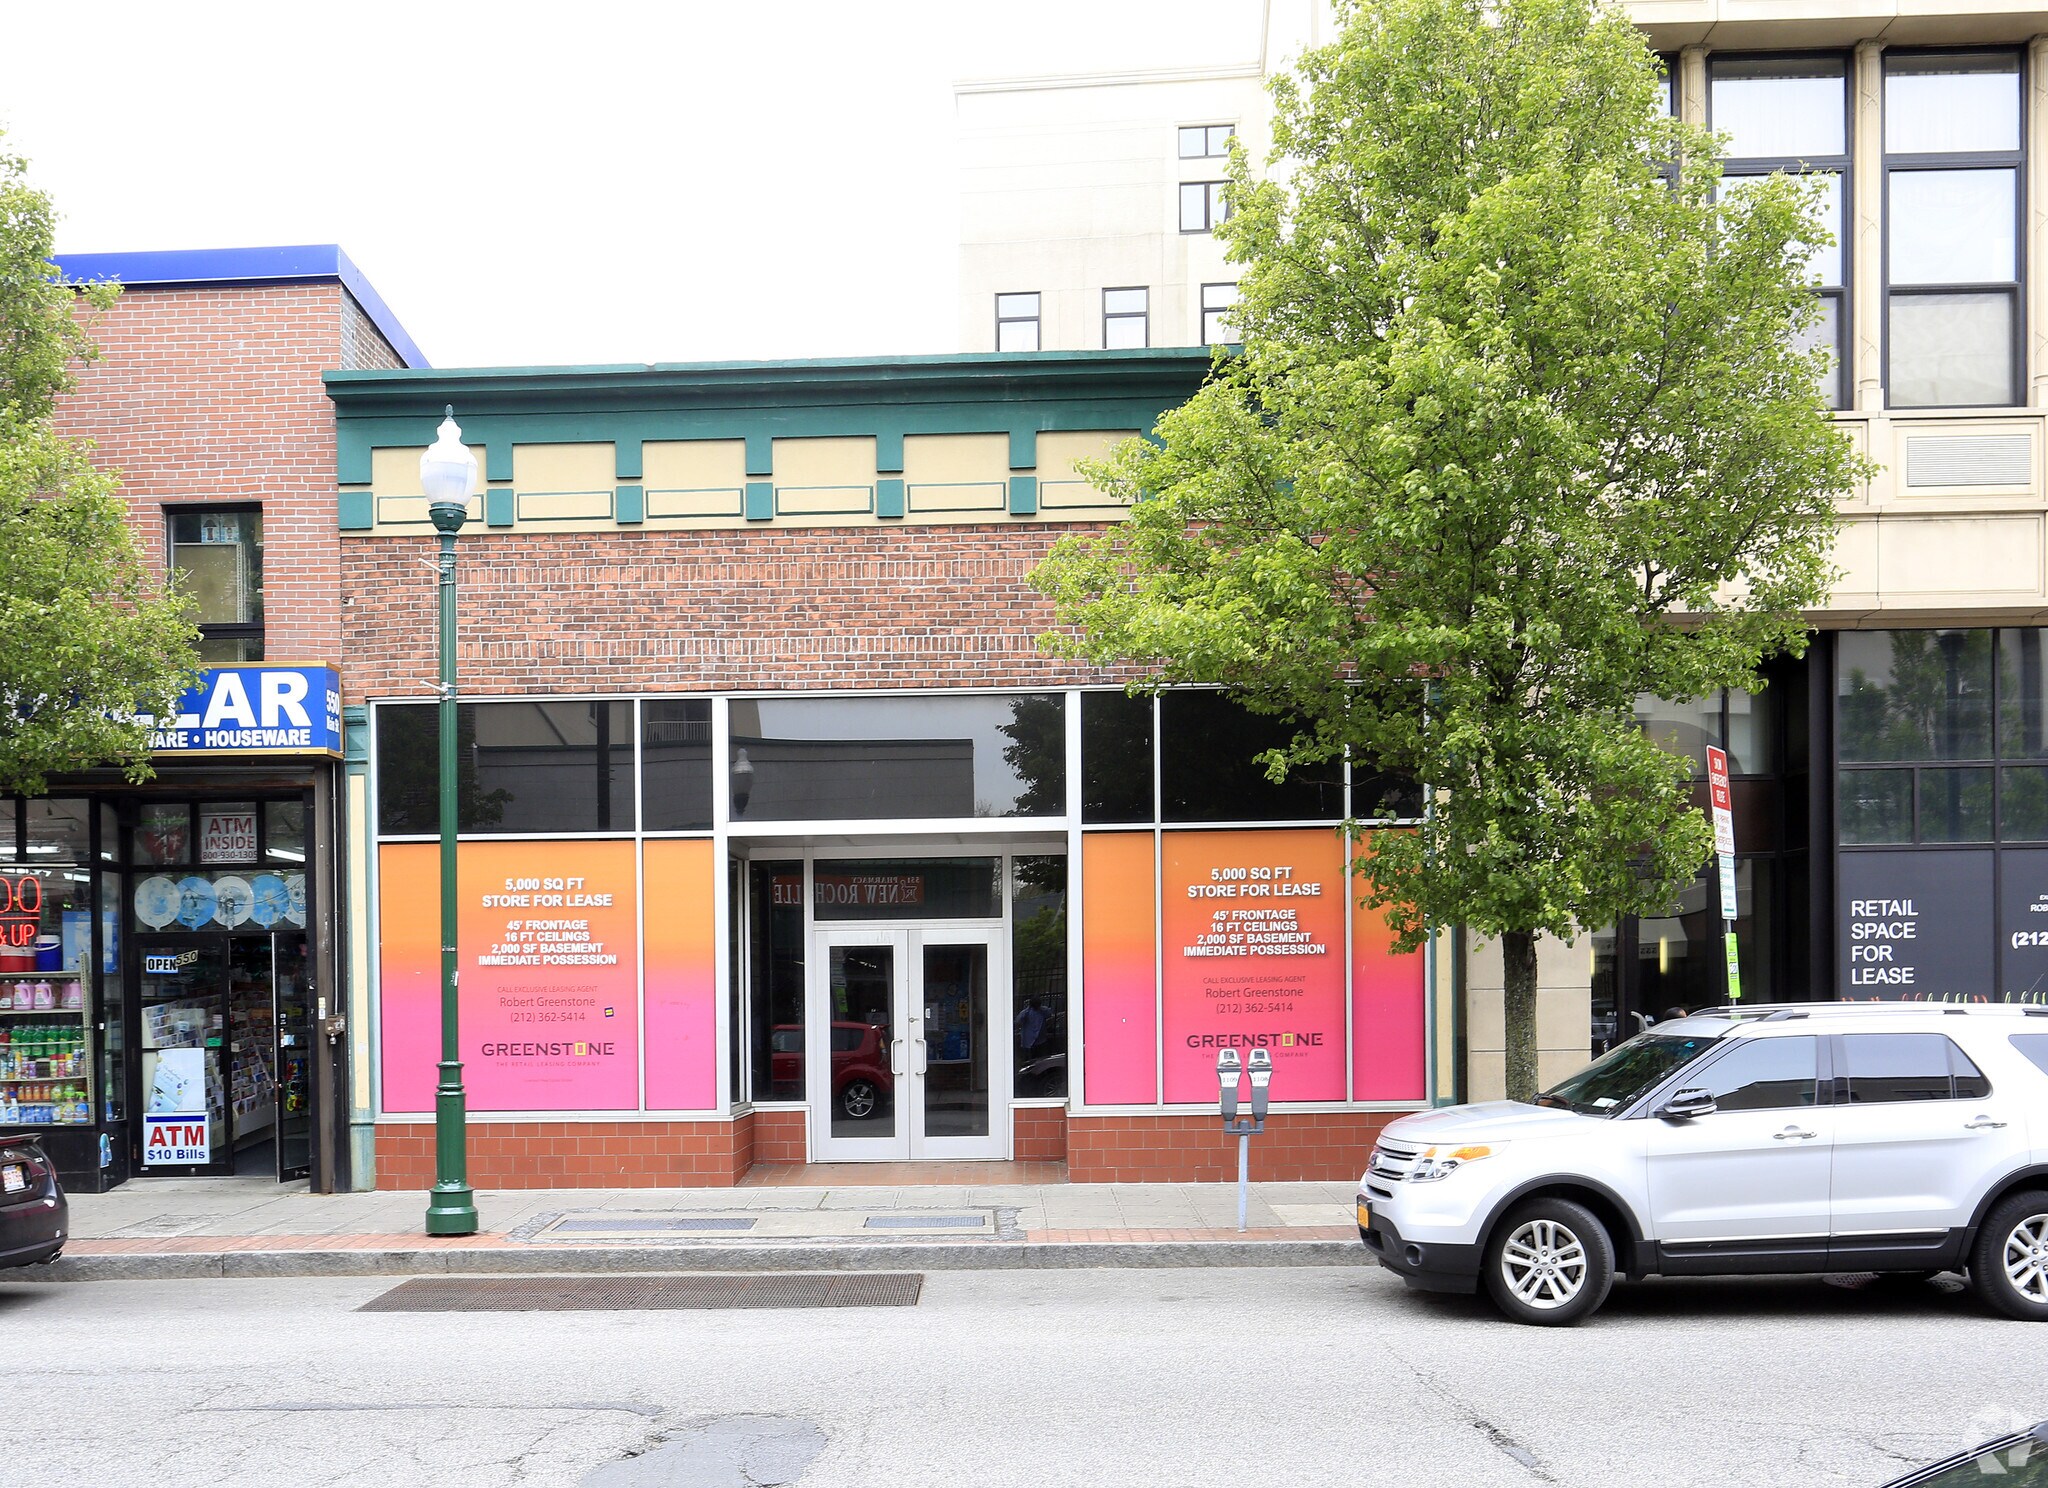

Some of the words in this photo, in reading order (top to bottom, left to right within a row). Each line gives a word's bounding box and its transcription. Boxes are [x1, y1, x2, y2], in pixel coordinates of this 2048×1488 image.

[205, 729, 311, 747] HOUSEWARE
[208, 817, 252, 834] ATM
[205, 836, 255, 850] INSIDE
[1211, 868, 1247, 883] 5,000
[1250, 867, 1271, 881] SQ
[1274, 867, 1292, 880] FT
[505, 878, 540, 892] 5,000
[543, 878, 564, 891] SQ
[567, 878, 585, 890] FT
[1187, 885, 1237, 898] STORE
[1240, 885, 1271, 897] FOR
[1274, 883, 1321, 896] LEASE
[482, 895, 530, 908] STORE
[533, 895, 563, 907] FOR
[566, 894, 613, 906] LEASE
[1212, 911, 1229, 921] 45'
[1232, 909, 1296, 920] FRONTAGE
[1851, 900, 1919, 917] RETAIL
[525, 920, 588, 930] FRONTAGE
[1210, 923, 1224, 933] 16
[1227, 922, 1241, 932] FT
[1243, 921, 1298, 932] CEILINGS
[1851, 922, 1917, 939] SPACE
[11, 924, 35, 946] UP
[505, 932, 517, 942] 16
[520, 932, 535, 942] FT
[537, 931, 590, 942] CEILINGS
[1197, 934, 1226, 946] 2,000
[1229, 933, 1244, 944] SF
[1246, 932, 1312, 944] BASEMENT
[491, 944, 520, 955] 2,000
[522, 944, 537, 953] SF
[540, 943, 603, 953] BASEMENT
[1183, 945, 1247, 957] IMMEDIATE
[1249, 944, 1326, 956] POSSESSION
[1851, 945, 1893, 962] FOR
[148, 959, 177, 970] OPEN
[176, 952, 197, 964] 550
[478, 955, 541, 966] IMMEDIATE
[543, 954, 617, 965] POSSESSION
[1284, 975, 1306, 983] AGENT
[1851, 967, 1915, 985] LEASE
[576, 985, 598, 993] AGENT
[1205, 988, 1241, 998] Robert
[1243, 987, 1304, 998] Greenstone
[500, 997, 534, 1007] Robert
[536, 996, 596, 1007] Greenstone
[1216, 1004, 1242, 1014] (212)
[1245, 1003, 1293, 1013] 362-5414
[510, 1012, 536, 1023] (212)
[538, 1012, 586, 1022] 362-5414
[1186, 1032, 1323, 1048] GREENSTONE
[481, 1040, 614, 1056] GREENSTONE
[148, 1126, 205, 1147] ATM
[148, 1150, 171, 1160] $10
[176, 1149, 206, 1159] Bills
